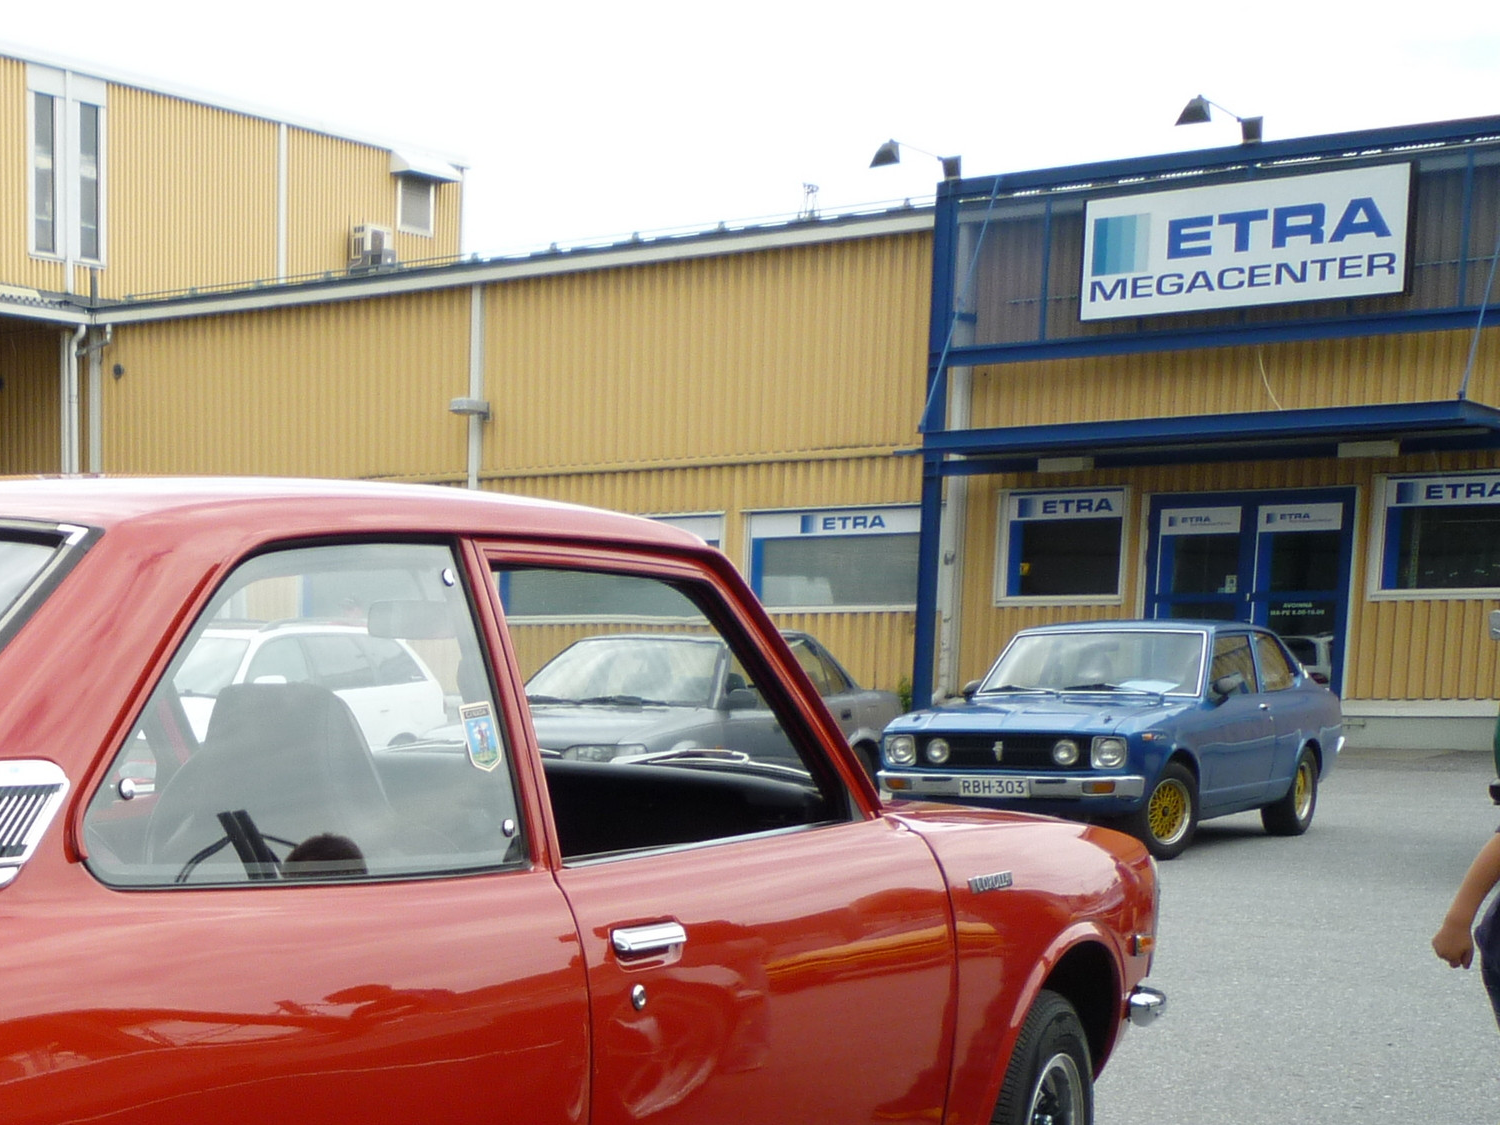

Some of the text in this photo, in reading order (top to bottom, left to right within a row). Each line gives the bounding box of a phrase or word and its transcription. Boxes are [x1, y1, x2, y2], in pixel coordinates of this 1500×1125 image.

[1167, 197, 1392, 260] ETRA
[1089, 252, 1397, 302] MEGACENTER
[1041, 498, 1113, 514] ETRA
[822, 514, 886, 530] ETRA
[1181, 515, 1211, 524] ETRA
[1280, 512, 1310, 521] ETRA
[962, 779, 1025, 794] RBH-303
